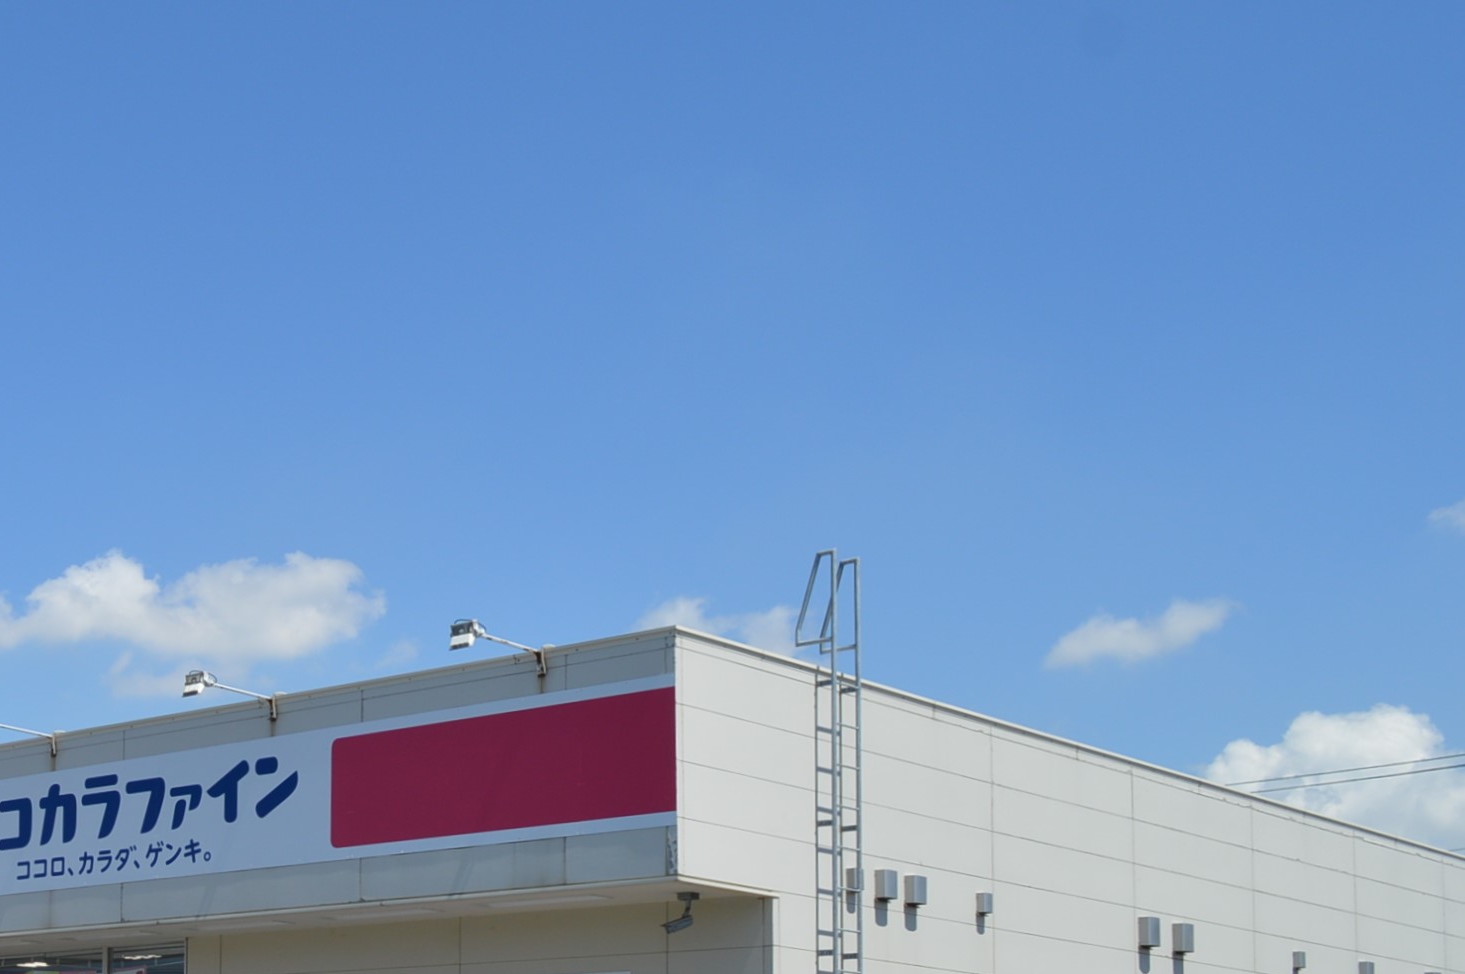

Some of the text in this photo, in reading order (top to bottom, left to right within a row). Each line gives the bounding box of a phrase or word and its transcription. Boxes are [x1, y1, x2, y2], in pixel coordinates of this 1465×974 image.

[17, 838, 212, 881] ココロ、カラダ、ゲンキ。
